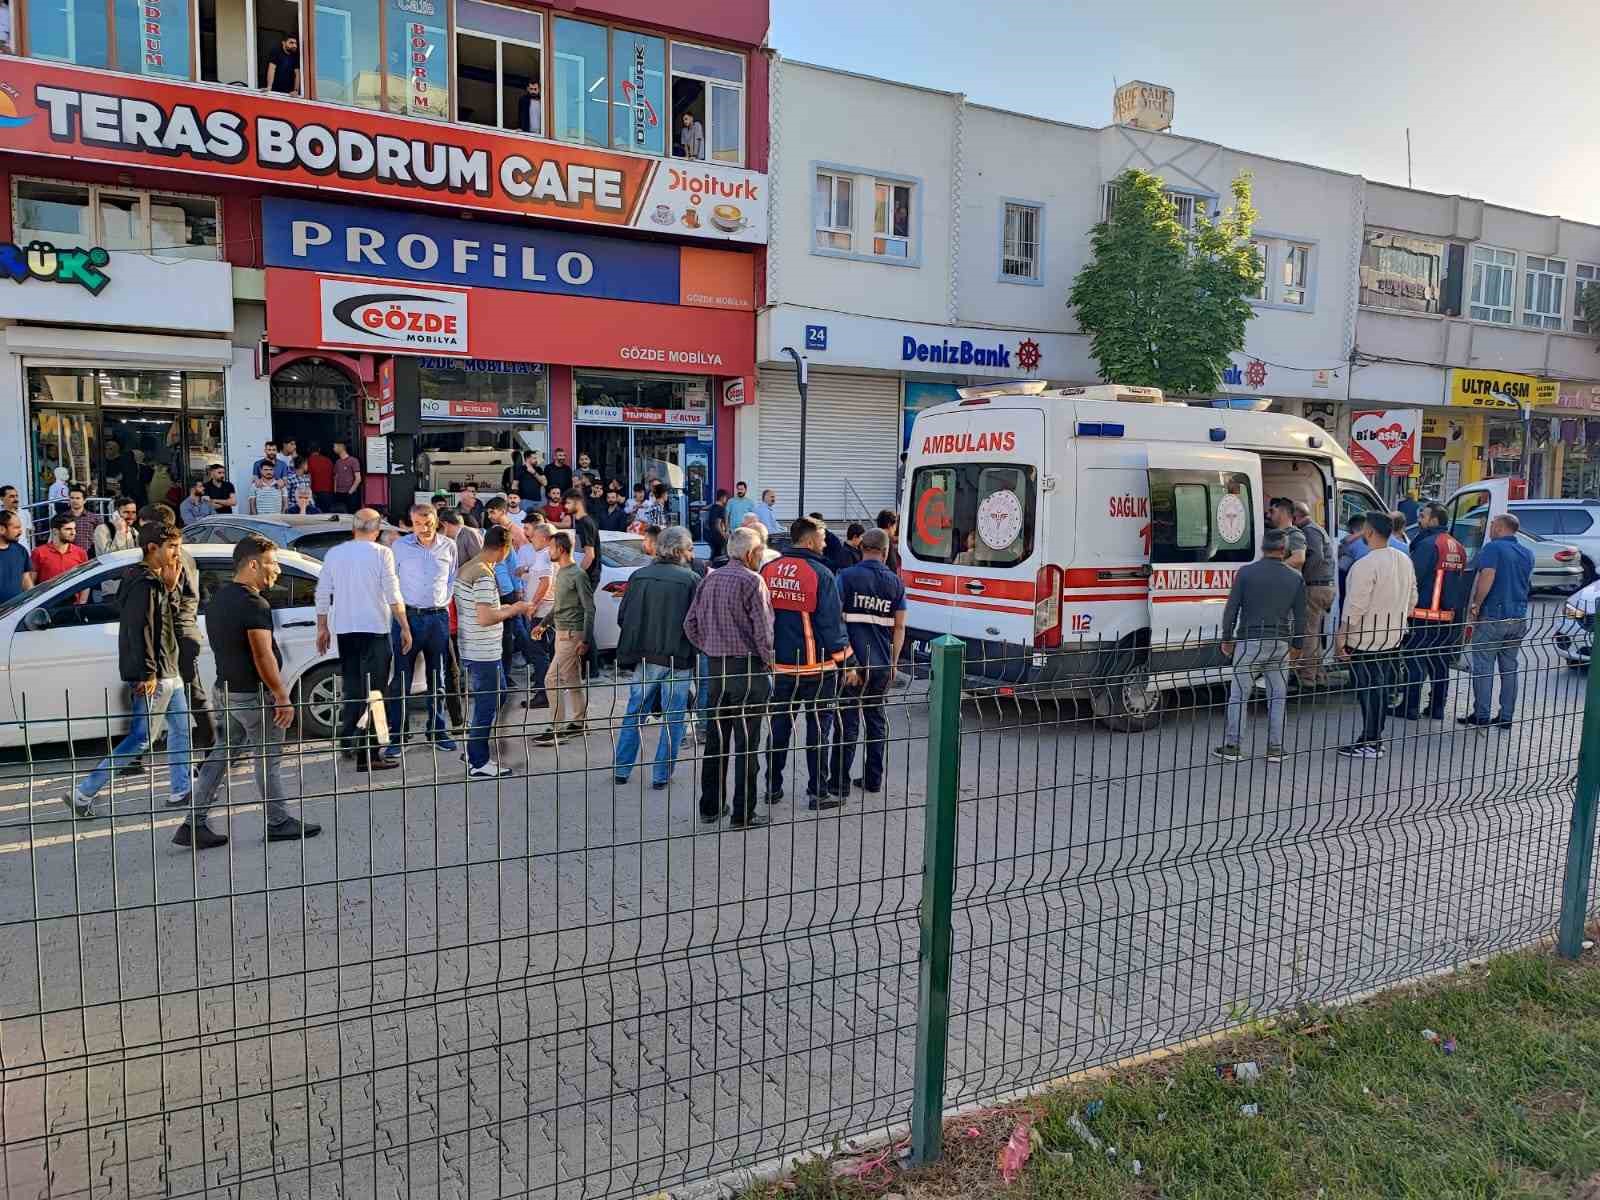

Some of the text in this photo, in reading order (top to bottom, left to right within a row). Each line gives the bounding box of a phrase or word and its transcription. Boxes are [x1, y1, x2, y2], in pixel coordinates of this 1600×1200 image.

[144, 0, 163, 65] DRUM
[412, 23, 429, 106] BODRUM
[36, 84, 624, 210] TERAS BODRUM CAFE
[668, 168, 758, 205] Digiturk
[362, 304, 457, 334] GÖZDE
[809, 328, 825, 342] 24
[620, 345, 665, 361] GÖZDE
[902, 335, 1010, 368] DenizBank
[1462, 378, 1530, 398] ULTRA GSM
[922, 431, 1016, 454] AMBULANS
[1109, 493, 1148, 518] SAĞLIK
[777, 563, 798, 577] 112
[1155, 569, 1237, 590] AMBULAN
[1072, 614, 1092, 631] 112
